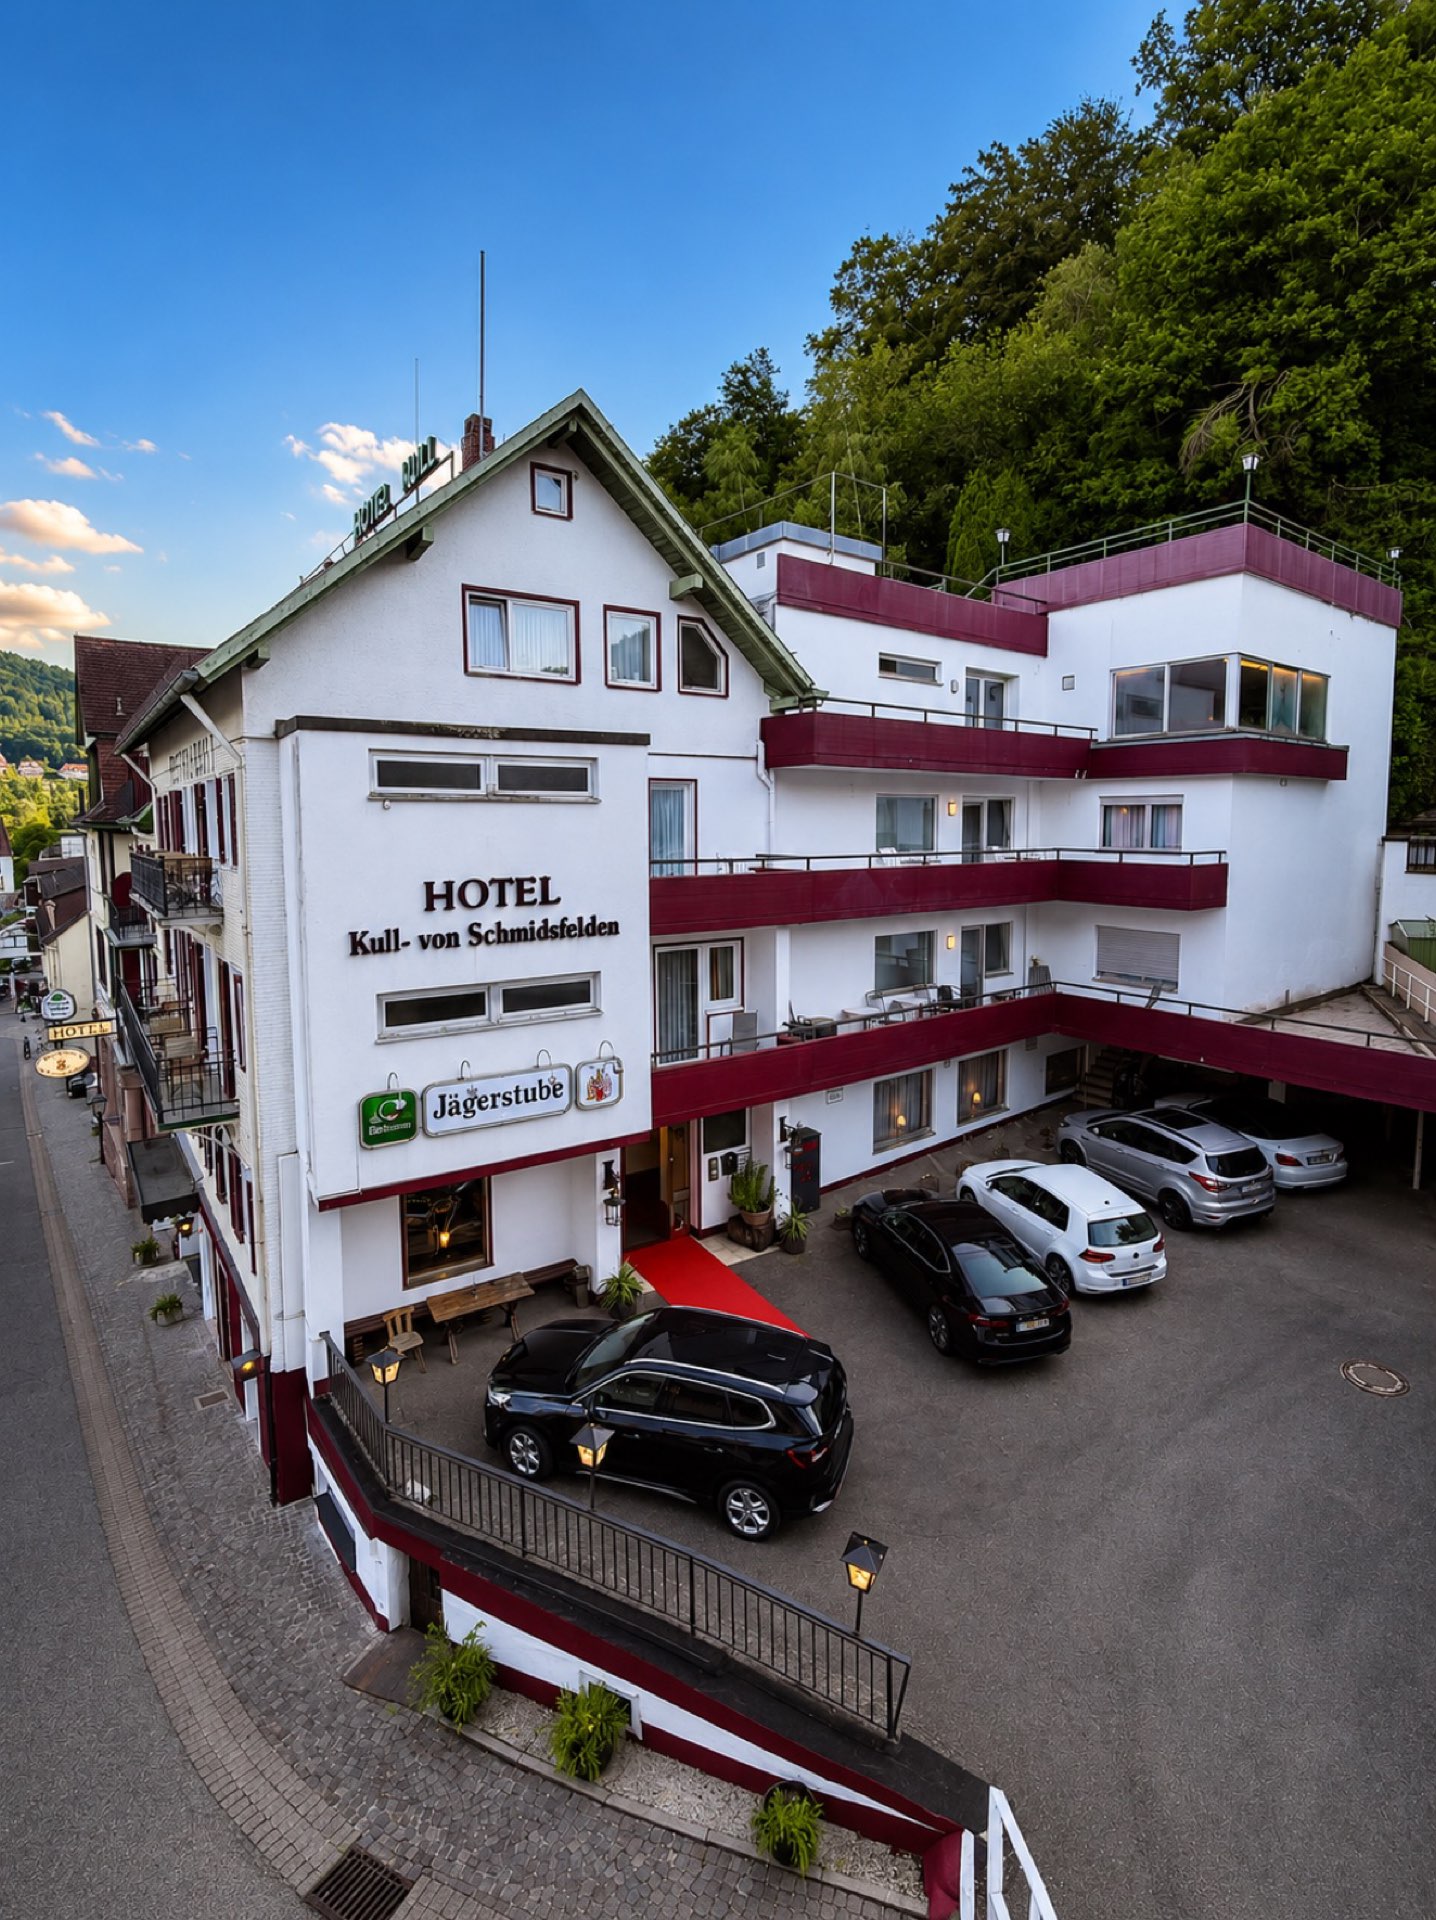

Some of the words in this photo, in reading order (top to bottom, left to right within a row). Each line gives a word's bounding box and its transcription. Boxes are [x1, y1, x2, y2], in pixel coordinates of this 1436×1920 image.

[423, 876, 562, 912] HOTEL
[348, 928, 411, 956] Kull-
[419, 931, 461, 951] von
[467, 915, 620, 947] Schmidsfelden
[53, 1022, 109, 1039] HOTEL
[432, 1079, 564, 1119] Jägerstube
